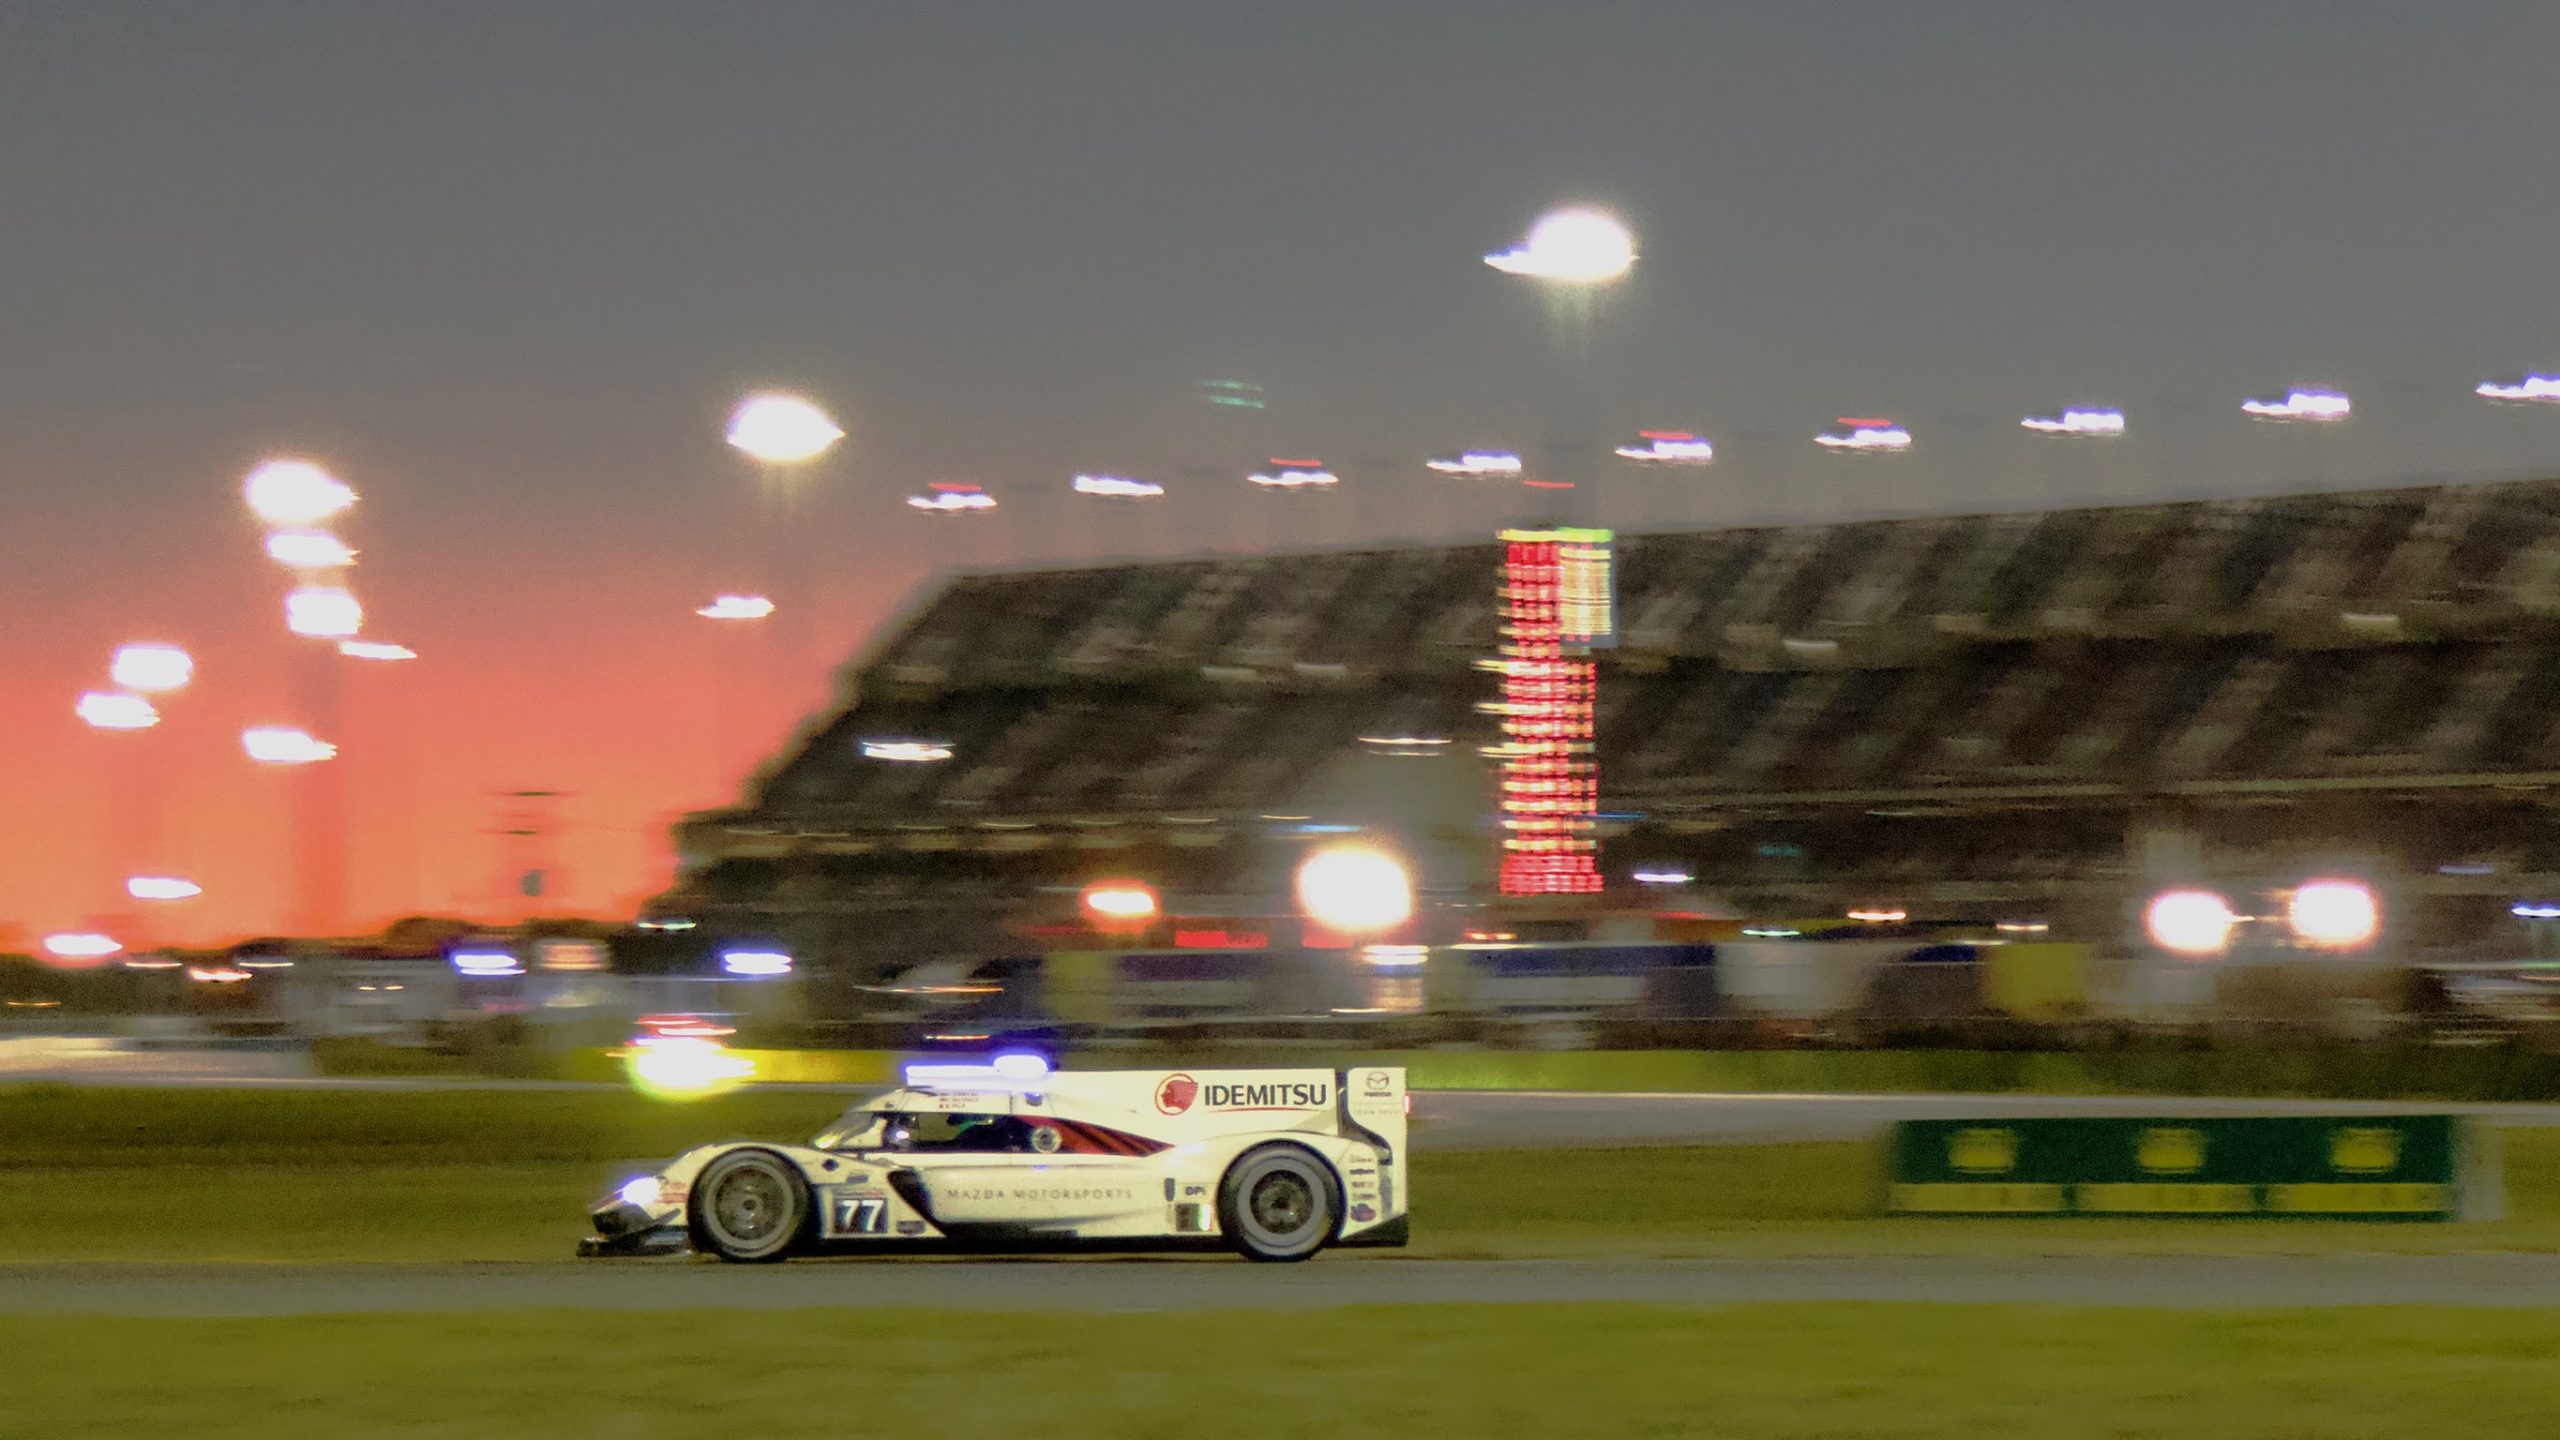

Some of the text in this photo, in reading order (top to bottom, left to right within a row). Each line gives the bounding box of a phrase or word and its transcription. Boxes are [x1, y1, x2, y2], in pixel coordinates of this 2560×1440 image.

[1205, 1084, 1327, 1106] IDEMITSU
[947, 1189, 1132, 1200] MAZDA MOTORSPORTS
[841, 1199, 884, 1232] 77
